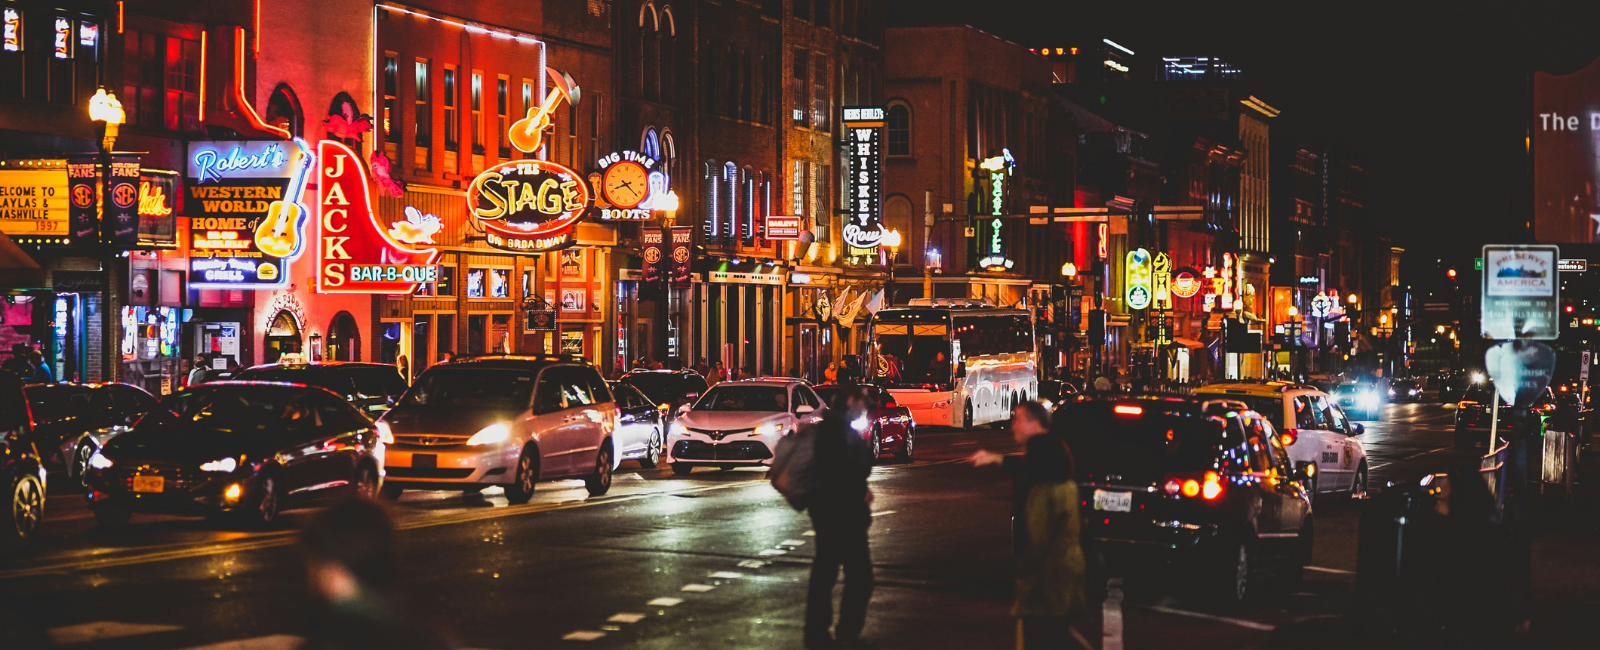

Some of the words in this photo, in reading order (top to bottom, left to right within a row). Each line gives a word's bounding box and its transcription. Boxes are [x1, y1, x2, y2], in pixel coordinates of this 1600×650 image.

[1539, 112, 1579, 131] The
[194, 143, 286, 184] Robert's
[598, 151, 620, 169] BIG
[623, 150, 655, 169] TIME
[69, 169, 95, 178] FANS
[112, 168, 140, 177] FANS
[516, 163, 540, 175] THE
[855, 128, 872, 226] WHISKEY
[0, 186, 35, 196] ELCOME
[41, 186, 55, 197] TO
[74, 185, 93, 205] SEC
[115, 185, 134, 205] SEC
[190, 186, 282, 199] WESTERN
[475, 172, 583, 220] STAGE
[42, 198, 48, 208] &
[202, 200, 270, 213] WORLD
[322, 154, 353, 287] JACKS
[601, 209, 650, 219] BOOTS
[36, 221, 58, 231] 1997
[191, 217, 247, 230] HOME
[248, 217, 260, 233] of
[487, 233, 502, 246] ON
[507, 233, 567, 249] BROADWAY
[847, 224, 880, 245] Row
[214, 249, 233, 258] Tonk
[234, 249, 262, 258] Heaven
[350, 266, 436, 282] BAR-B-QUE
[1497, 279, 1546, 287] AMERICA
